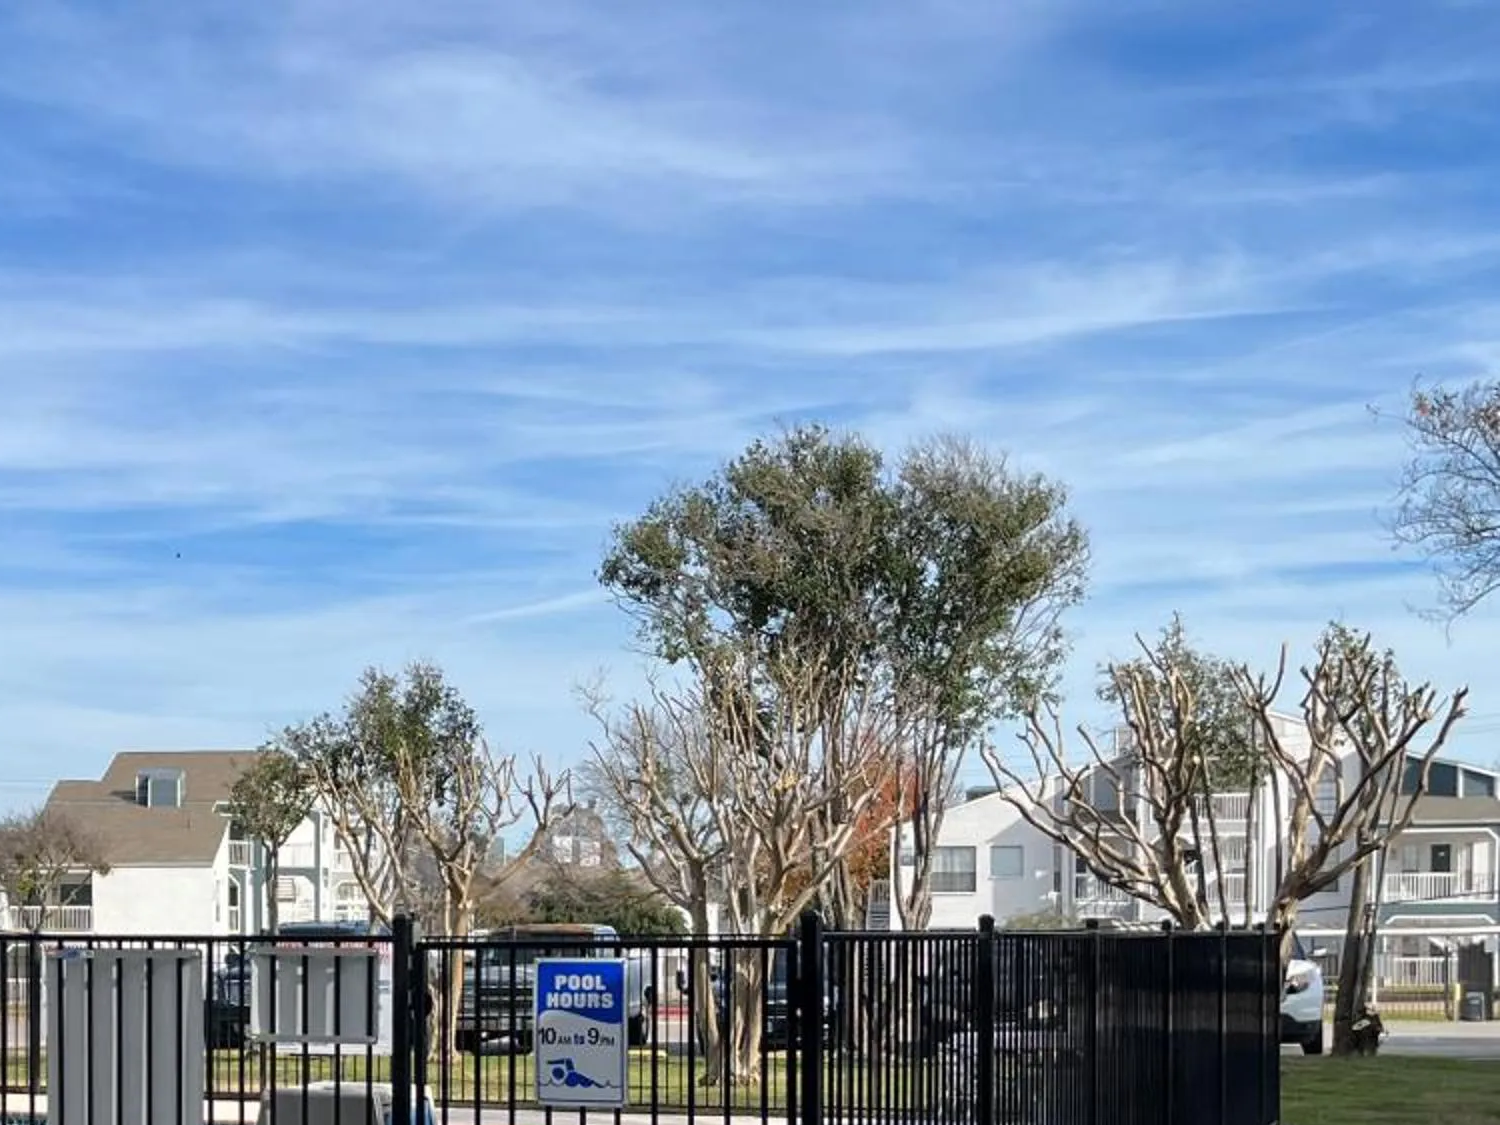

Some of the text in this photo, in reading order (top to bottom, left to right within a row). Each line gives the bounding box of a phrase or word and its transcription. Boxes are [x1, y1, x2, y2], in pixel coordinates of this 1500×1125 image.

[554, 974, 607, 991] POOL
[546, 991, 614, 1009] HOURS
[573, 1032, 585, 1045] to
